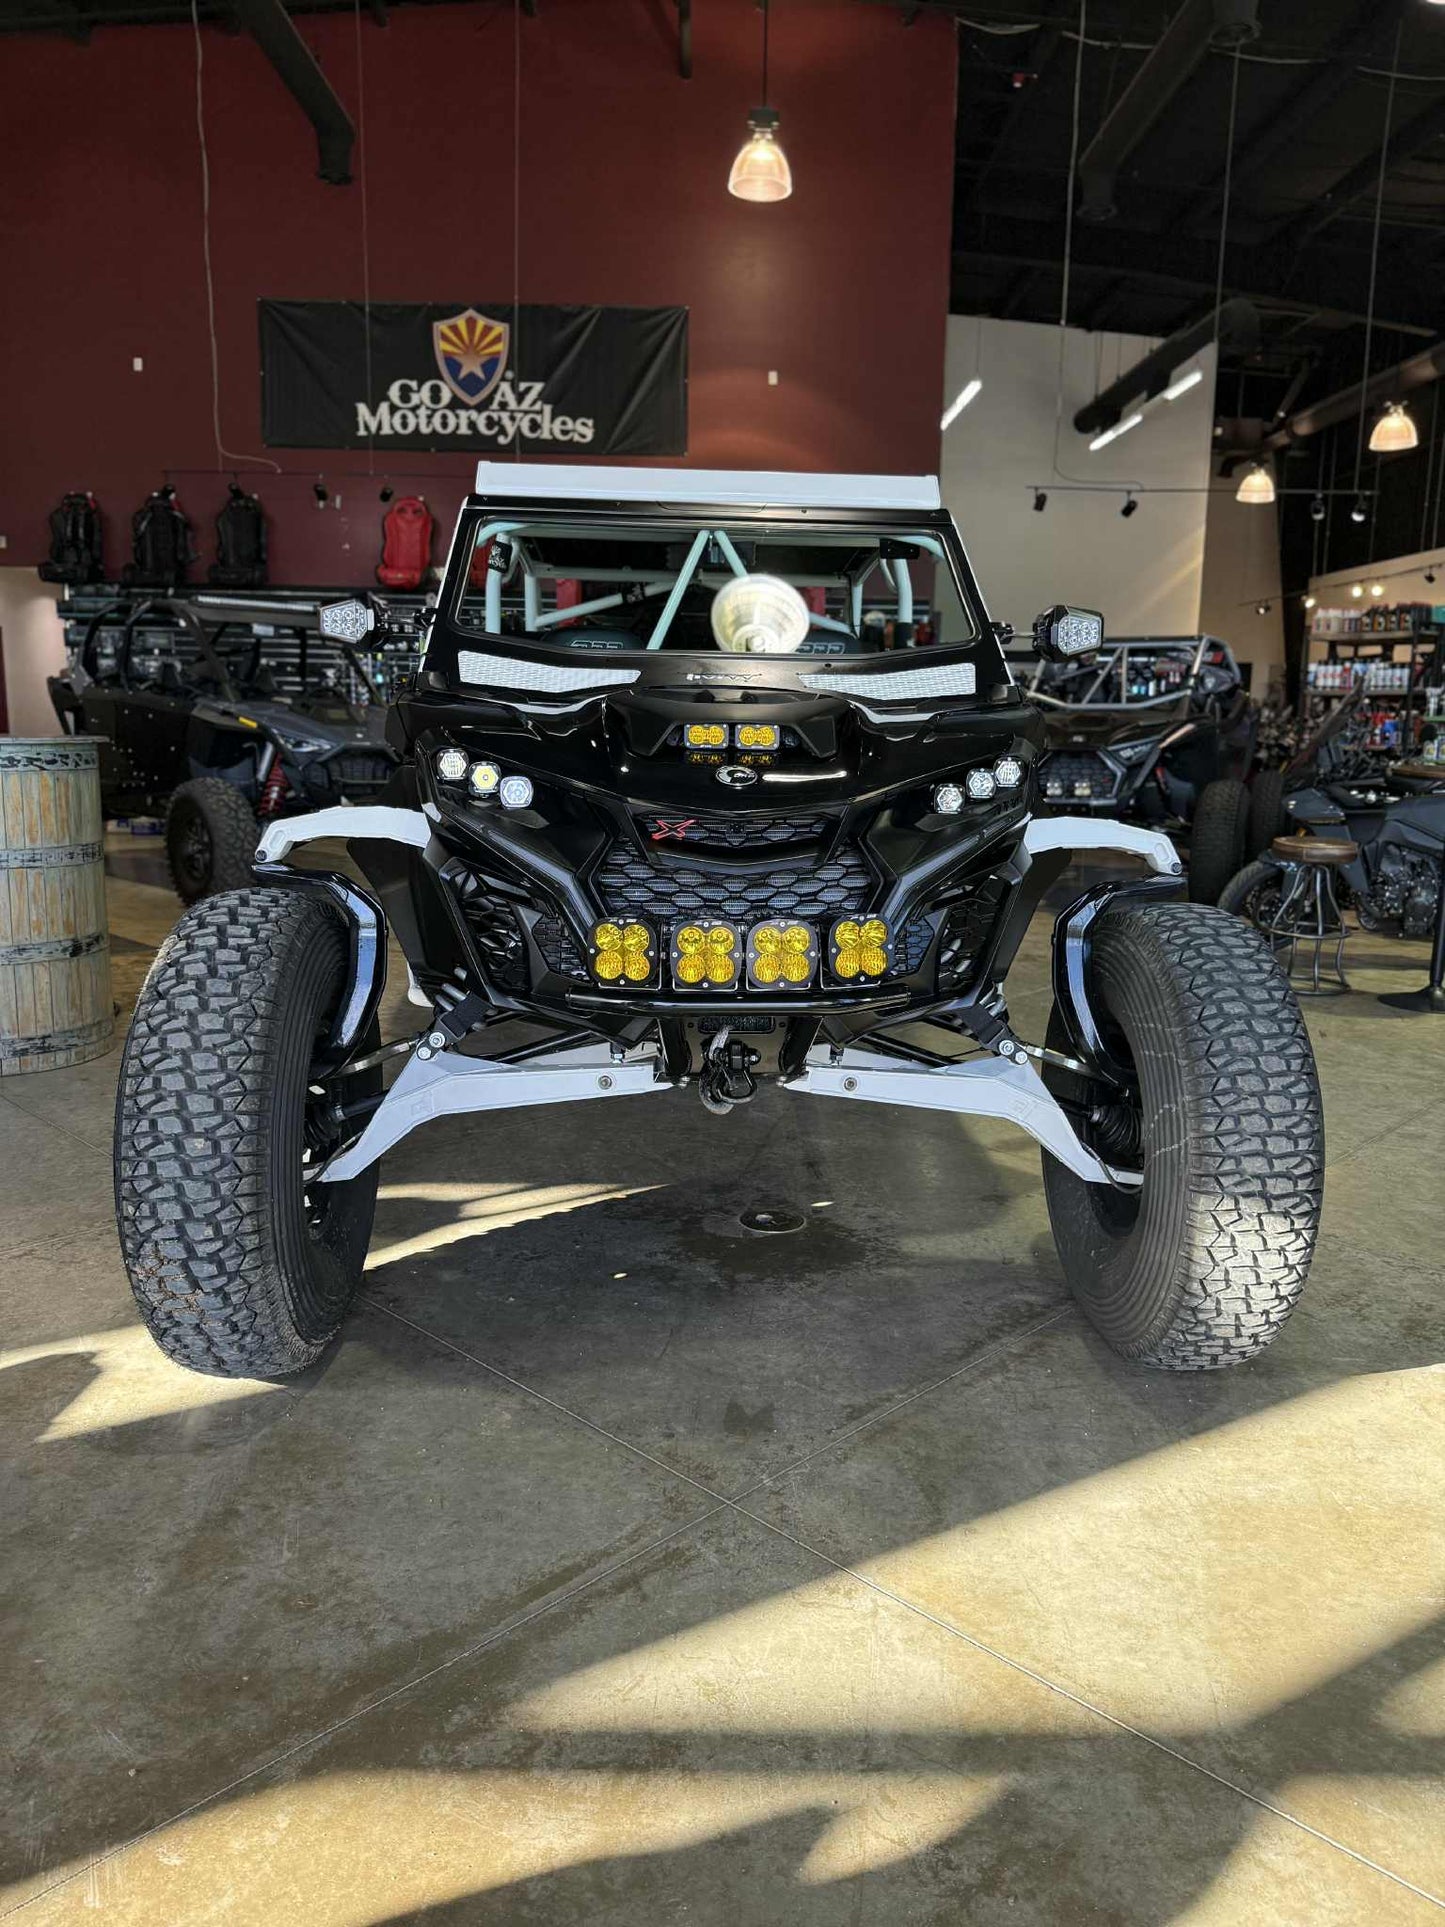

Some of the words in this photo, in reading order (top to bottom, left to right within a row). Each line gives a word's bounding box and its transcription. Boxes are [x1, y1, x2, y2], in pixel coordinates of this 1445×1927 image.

[387, 379, 453, 409] GO
[490, 381, 547, 412] AZ
[355, 402, 595, 444] Motorcycles
